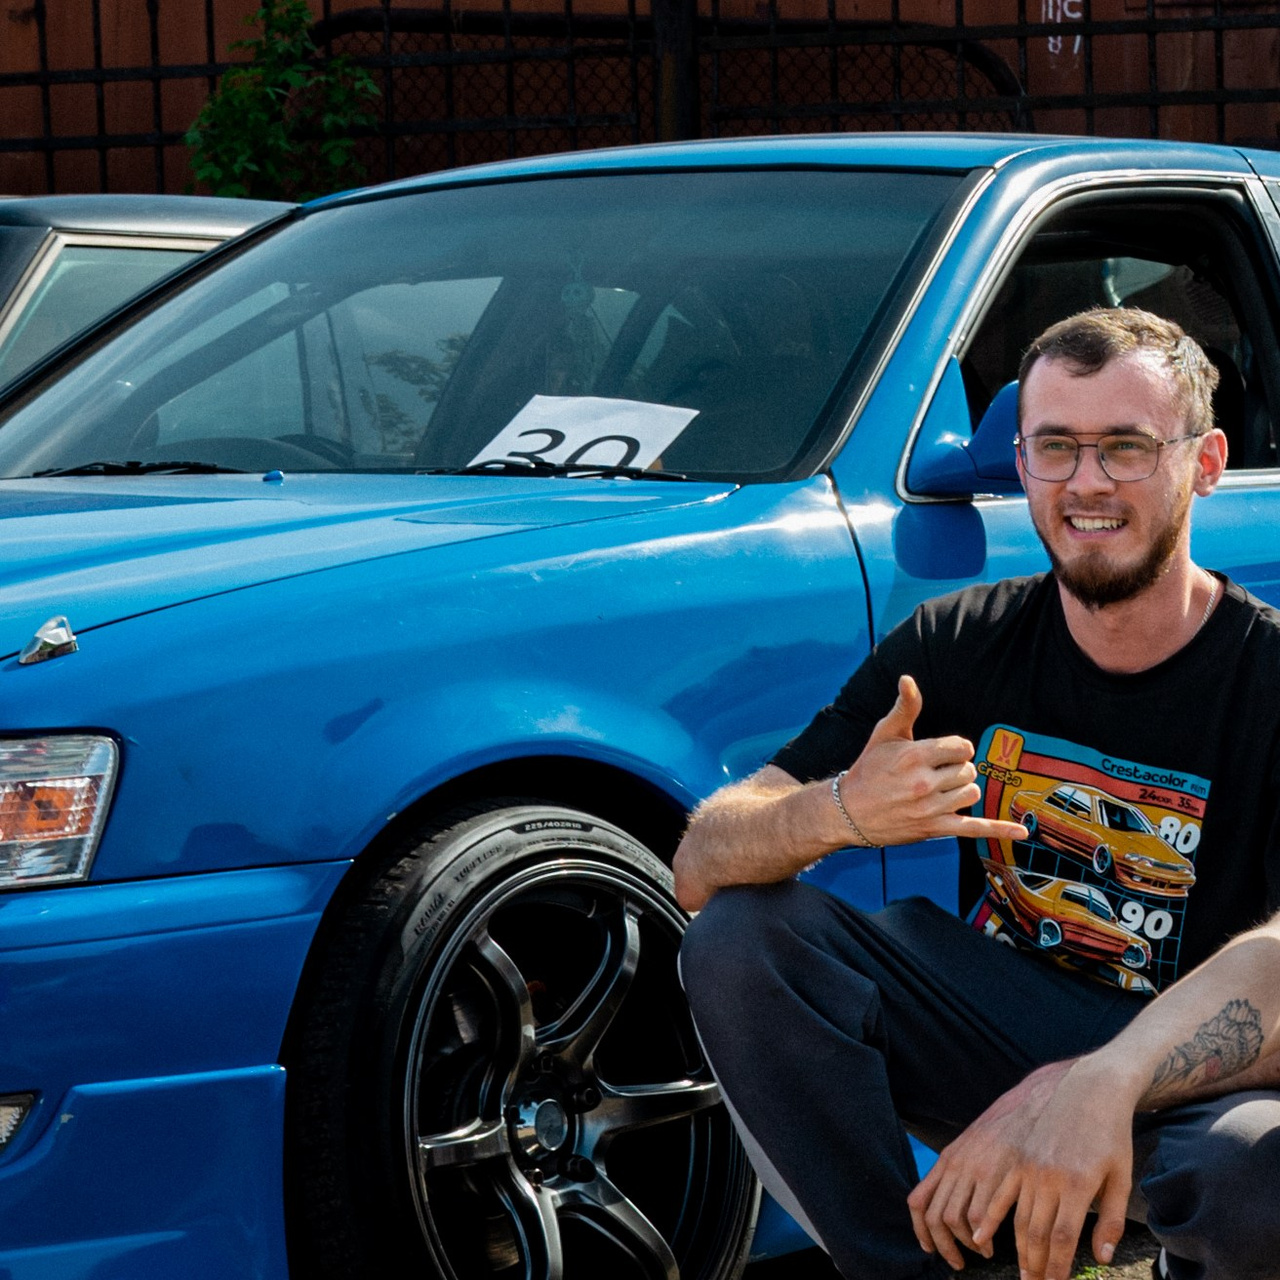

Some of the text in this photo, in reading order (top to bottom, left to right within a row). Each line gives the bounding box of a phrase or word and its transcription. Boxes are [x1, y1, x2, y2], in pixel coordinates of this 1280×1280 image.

[976, 761, 1023, 788] Cresta
[1102, 758, 1188, 789] Crestacolor
[1160, 816, 1201, 854] 80
[1119, 901, 1174, 940] 90
